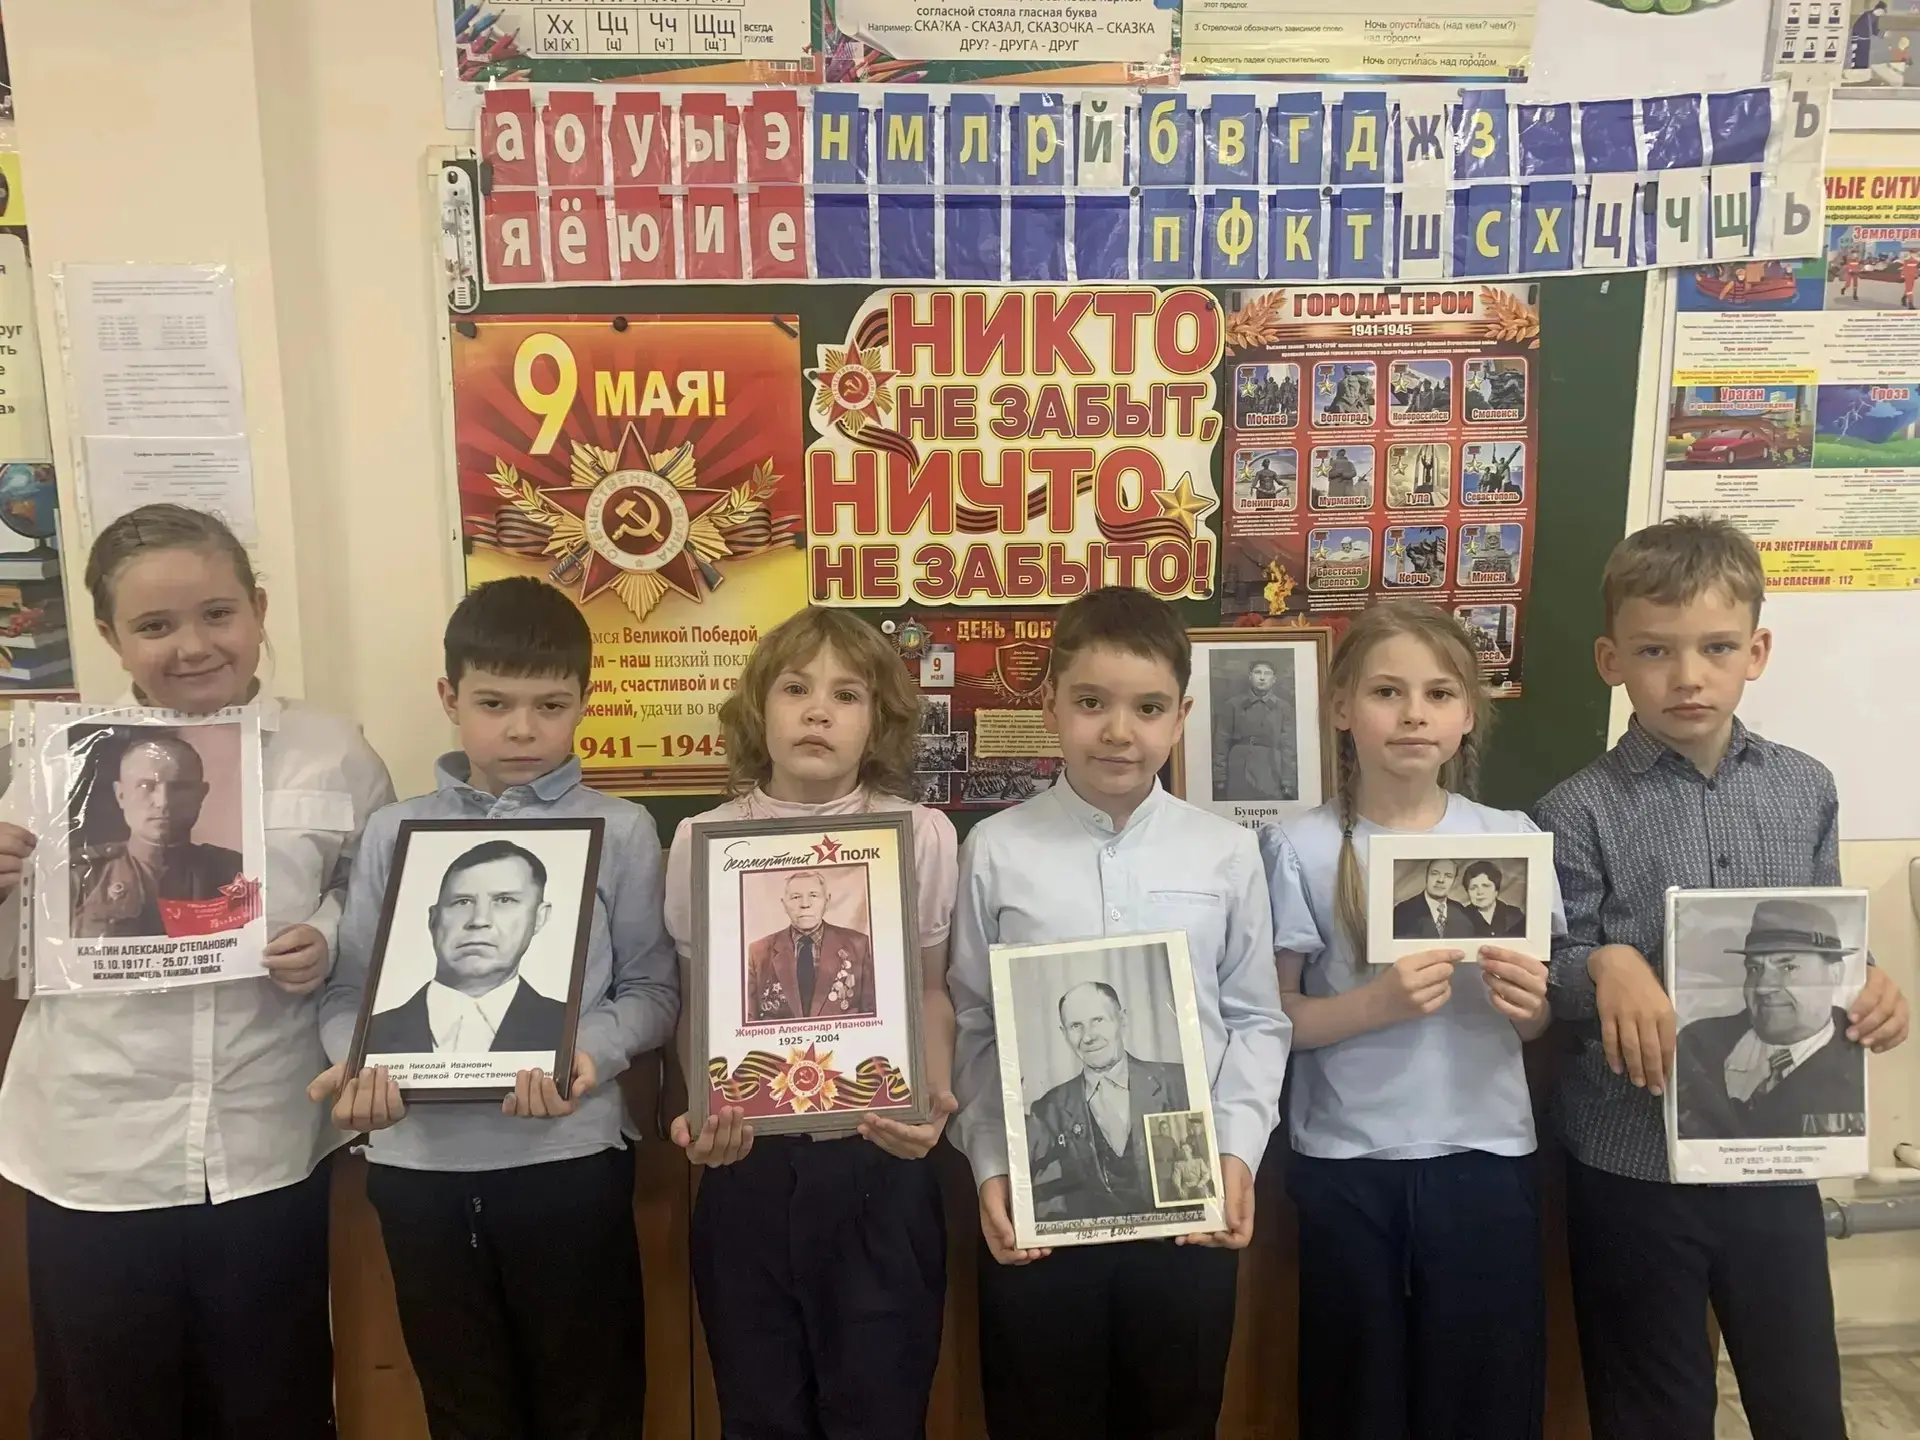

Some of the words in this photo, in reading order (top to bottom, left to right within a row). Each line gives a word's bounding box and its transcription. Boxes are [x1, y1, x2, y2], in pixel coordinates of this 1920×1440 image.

[917, 6, 975, 20] согласной
[978, 8, 1016, 17] стояла
[1019, 9, 1063, 18] гласная
[1065, 7, 1098, 20] буква
[547, 14, 574, 34] Хх
[597, 11, 628, 36] Цц
[650, 12, 677, 33] Чч
[694, 13, 736, 38] Щщ
[744, 24, 774, 33] ВСЕГДА
[867, 23, 913, 34] Например:
[914, 20, 961, 33] СКА?КА
[971, 20, 1025, 35] СКАЗАЛ,
[1027, 21, 1094, 34] СКАЗОЧКА
[1106, 21, 1155, 34] СКАЗКА
[1364, 20, 1387, 29] Ночь
[1390, 21, 1440, 33] опустилась
[1443, 20, 1463, 31] (над
[1490, 20, 1516, 32] чем?)
[960, 39, 990, 52] ДРУ?
[1000, 39, 1038, 53] ДРУГА
[1048, 39, 1080, 53] ДРУГ
[1200, 56, 1242, 64] Определить
[1363, 56, 1385, 65] Ночь
[1387, 57, 1437, 67] опустилась
[1440, 58, 1457, 66] над
[495, 111, 525, 162] а
[554, 113, 586, 163] о
[624, 114, 655, 178] у
[684, 114, 726, 163] ы
[763, 111, 791, 161] э
[820, 114, 849, 161] н
[887, 114, 925, 162] м
[960, 115, 988, 163] л
[1027, 112, 1057, 176] р
[1083, 100, 1112, 163] й
[1149, 99, 1179, 165] б
[1218, 119, 1246, 165] в
[1289, 117, 1310, 164] г
[1345, 115, 1378, 171] д
[1406, 114, 1444, 162] ж
[1470, 111, 1494, 159] з
[1791, 90, 1820, 139] ъ
[501, 217, 532, 267] я
[558, 196, 587, 265] ё
[618, 212, 660, 263] ю
[695, 204, 725, 254] и
[768, 212, 796, 263] е
[1153, 216, 1180, 262] п
[1216, 197, 1253, 266] ф
[1285, 215, 1313, 262] к
[1347, 214, 1372, 260] т
[1402, 214, 1441, 260] ш
[1475, 211, 1502, 258] с
[1533, 207, 1563, 254] х
[1594, 202, 1622, 259] ц
[1665, 196, 1691, 243] ч
[1714, 191, 1749, 248] щ
[1784, 191, 1811, 236] ь
[1293, 291, 1474, 318] ГОРОДА-ГЕРОИ
[890, 291, 1220, 376] НИКТО
[1350, 323, 1413, 336] 1941-1945
[513, 331, 578, 455] 9
[594, 370, 726, 416] МАЯ!
[1721, 388, 1764, 401] Ураган
[1872, 388, 1909, 400] Гроза
[896, 385, 978, 440] НЕ
[990, 383, 1218, 441] ЗАБЫТ,
[1321, 412, 1367, 424] Волгоград
[1393, 410, 1448, 421] Новороссийск
[1471, 409, 1518, 419] Смоленск
[1247, 413, 1287, 425] Москва
[809, 447, 1165, 535] НИЧТО
[1466, 492, 1519, 502] Севастополь
[1240, 498, 1290, 508] Ленинград
[1319, 496, 1365, 506] Мурманск
[1406, 492, 1429, 504] Тула
[1774, 541, 1837, 551] ЭКСТРЕННЫХ
[1840, 540, 1873, 550] СЛУЖБ
[811, 545, 900, 599] НЕ
[913, 541, 1213, 598] ЗАБЫТО!
[1317, 567, 1361, 577] Брестская
[1319, 578, 1358, 587] крепость
[1399, 573, 1430, 584] Керчь
[1472, 572, 1506, 582] Минск
[1784, 576, 1830, 586] СПАСЕНИЯ
[1839, 576, 1853, 585] 112
[623, 626, 688, 643] Великой
[957, 621, 1005, 641] ДЕНЬ
[1015, 621, 1056, 639] ПОБ
[620, 655, 650, 668] наш
[655, 650, 709, 668] низкий
[933, 658, 941, 671] 9
[621, 674, 706, 692] счастливой
[710, 678, 719, 690] и
[641, 703, 682, 721] удачи
[687, 703, 704, 715] во
[1234, 806, 1278, 818] Буцеров
[121, 943, 178, 955] АЛЕКСАНДР
[180, 938, 238, 953] СТЕПАНОВИЧ
[93, 972, 124, 980] МЕХАНИК
[126, 970, 161, 979] ВОДИТЕЛЬ
[163, 968, 198, 977] ТАНКОВЫХ
[201, 965, 221, 973] ВОЙСК
[735, 1027, 775, 1038] Жирнов
[778, 1023, 832, 1034] Александр
[835, 1020, 883, 1030] Иванович
[779, 1036, 803, 1045] 1925
[815, 1034, 840, 1043] 2004
[409, 1062, 446, 1070] Николай
[413, 1072, 449, 1080] Великой
